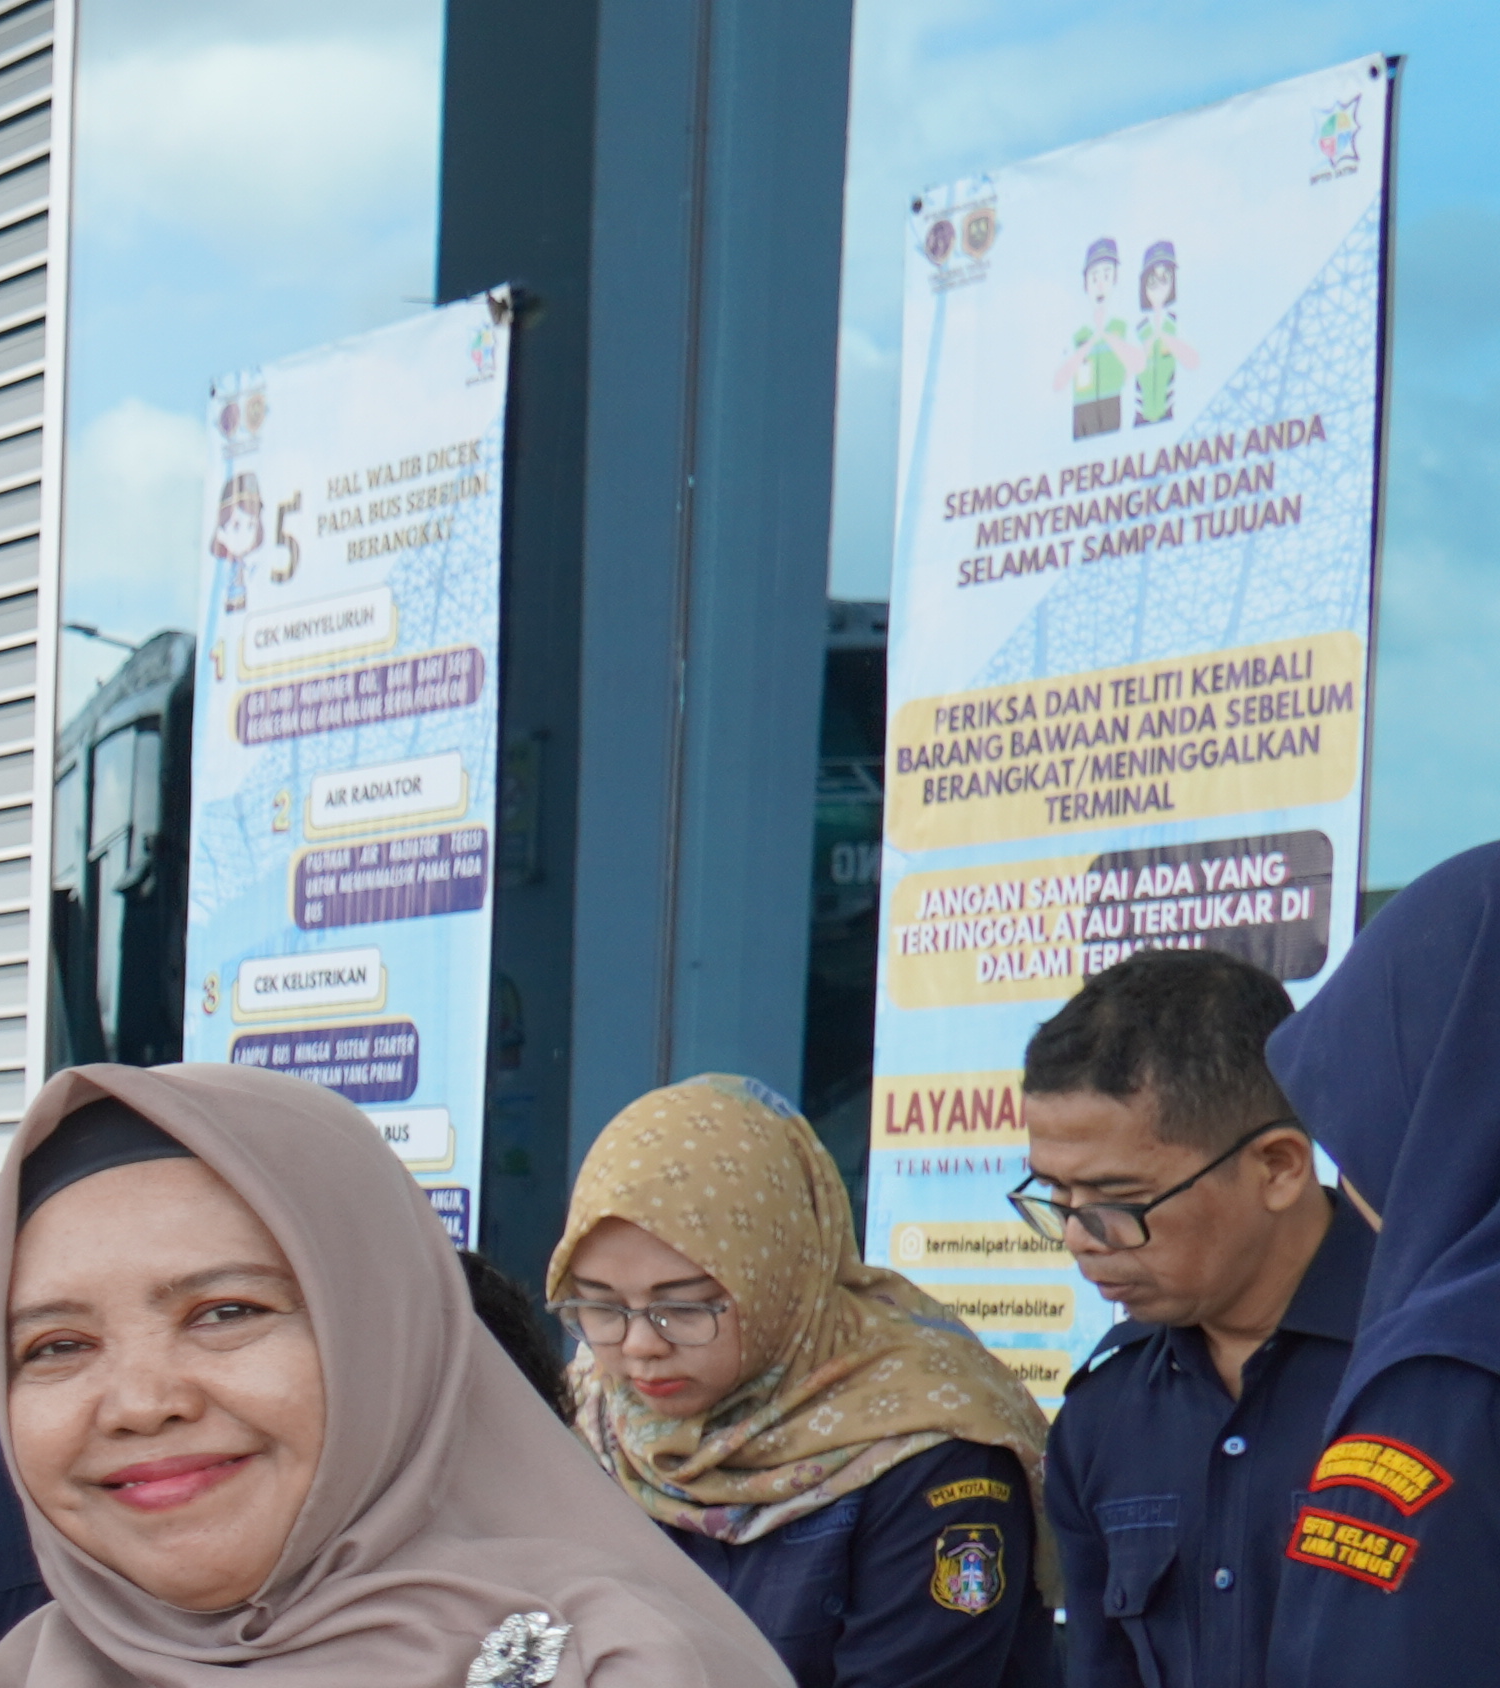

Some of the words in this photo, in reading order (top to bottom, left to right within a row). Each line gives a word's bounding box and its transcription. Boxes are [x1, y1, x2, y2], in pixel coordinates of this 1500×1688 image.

[367, 456, 421, 491] WAJIB
[426, 437, 482, 472] DICEK
[943, 473, 1053, 522] SEMOGA
[1058, 426, 1235, 497] PERJALANAN
[1241, 413, 1327, 462] ANDA
[316, 507, 364, 538] PADA
[368, 498, 401, 525] BUS
[975, 477, 1206, 549] MENYENANGKAN
[1213, 461, 1276, 509] DAN
[270, 490, 302, 585] 5
[956, 538, 1075, 588] SELAMAT
[1081, 518, 1184, 565] SAMPAI
[1191, 493, 1302, 542] TUJUAN
[254, 623, 280, 650] CEK
[284, 606, 375, 642] MENYELURUH
[933, 688, 1038, 735] PERIKSA
[1044, 681, 1102, 719] DAN
[1109, 669, 1184, 710] TELITI
[1190, 650, 1313, 697] KEMBALI
[897, 733, 1003, 775] BARANG
[1009, 717, 1130, 762] BAWAAN
[1136, 703, 1217, 742] ANDA
[1225, 681, 1355, 729] SEBELUM
[921, 725, 1321, 806] BERANGKAT/MENINGGALKAN
[271, 790, 291, 833] 2
[324, 787, 348, 808] AIR
[351, 775, 424, 805] RADIATOR
[1045, 781, 1176, 826] TERMINAL
[913, 880, 1023, 921] JANGAN
[1028, 868, 1130, 911] SAMPAI
[1134, 861, 1195, 899] ADA
[1201, 850, 1288, 891] YANG
[893, 909, 1049, 956] TERTINGGAL
[1052, 902, 1126, 943] ATAU
[1129, 888, 1276, 936] TERTUKAR
[1279, 884, 1311, 921] DI
[254, 976, 280, 995] CEK
[282, 966, 367, 991] KELISTRIKAN
[975, 946, 1072, 985] DALAM
[384, 1123, 409, 1141] BUS
[895, 1156, 1007, 1177] TERMINAL
[1301, 1535, 1337, 1559] JAWA
[1338, 1544, 1395, 1579] TIMUR
[1335, 1525, 1389, 1556] KELAS
